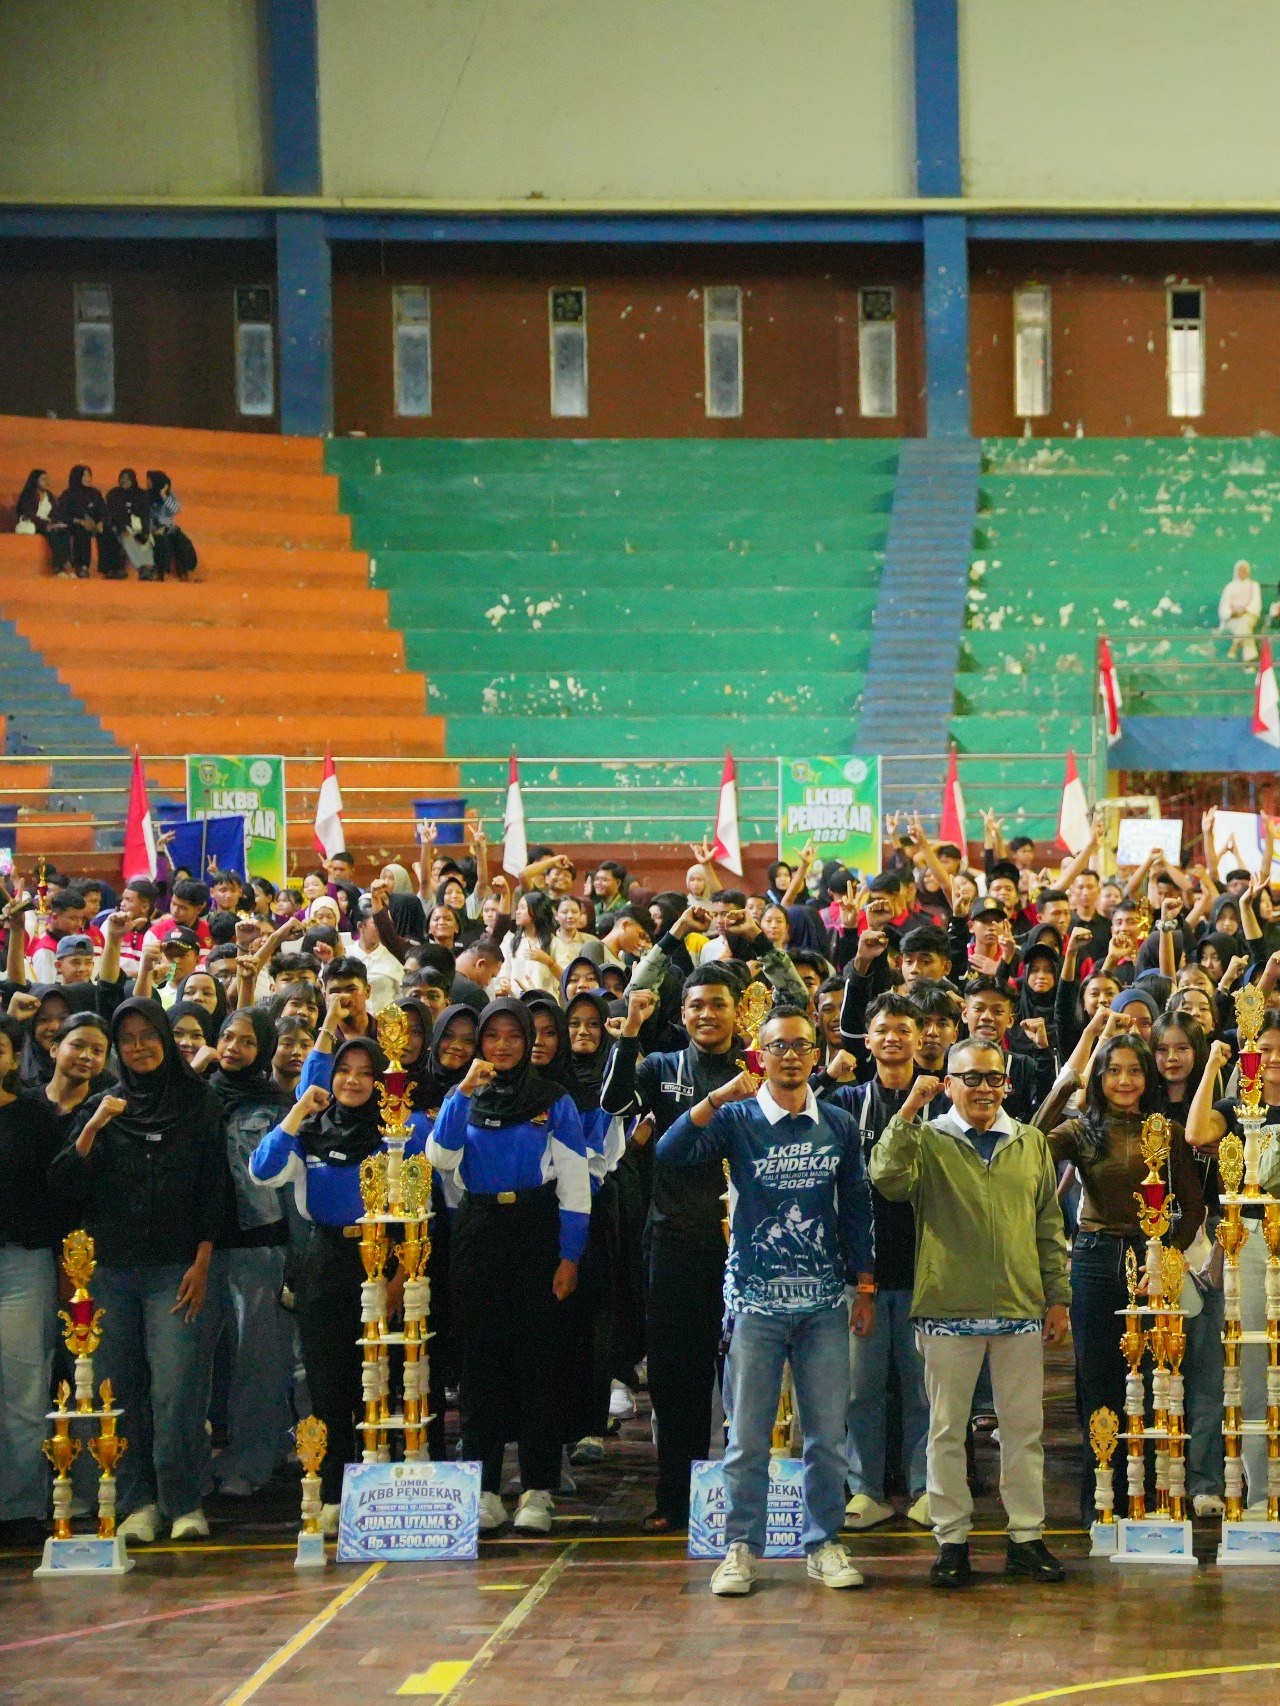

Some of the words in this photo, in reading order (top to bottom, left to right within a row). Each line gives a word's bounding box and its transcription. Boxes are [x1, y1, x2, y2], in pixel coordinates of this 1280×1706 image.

[213, 791, 259, 809] LKBB
[805, 787, 853, 805] LKBB
[787, 805, 872, 835] PENDEKAR
[767, 1142, 813, 1159] LKBB
[752, 1156, 840, 1179] PENDEKAR
[778, 1178, 816, 1190] 2026
[359, 1488, 393, 1507] LKBB
[397, 1488, 463, 1504] PENDEKAR
[361, 1516, 402, 1530] JUARA
[404, 1515, 446, 1530] UTAMA
[448, 1515, 457, 1530] 3
[767, 1513, 793, 1527] AMA
[795, 1513, 802, 1527] 2
[368, 1536, 386, 1550] Rp.
[390, 1535, 448, 1548] 1.500.000
